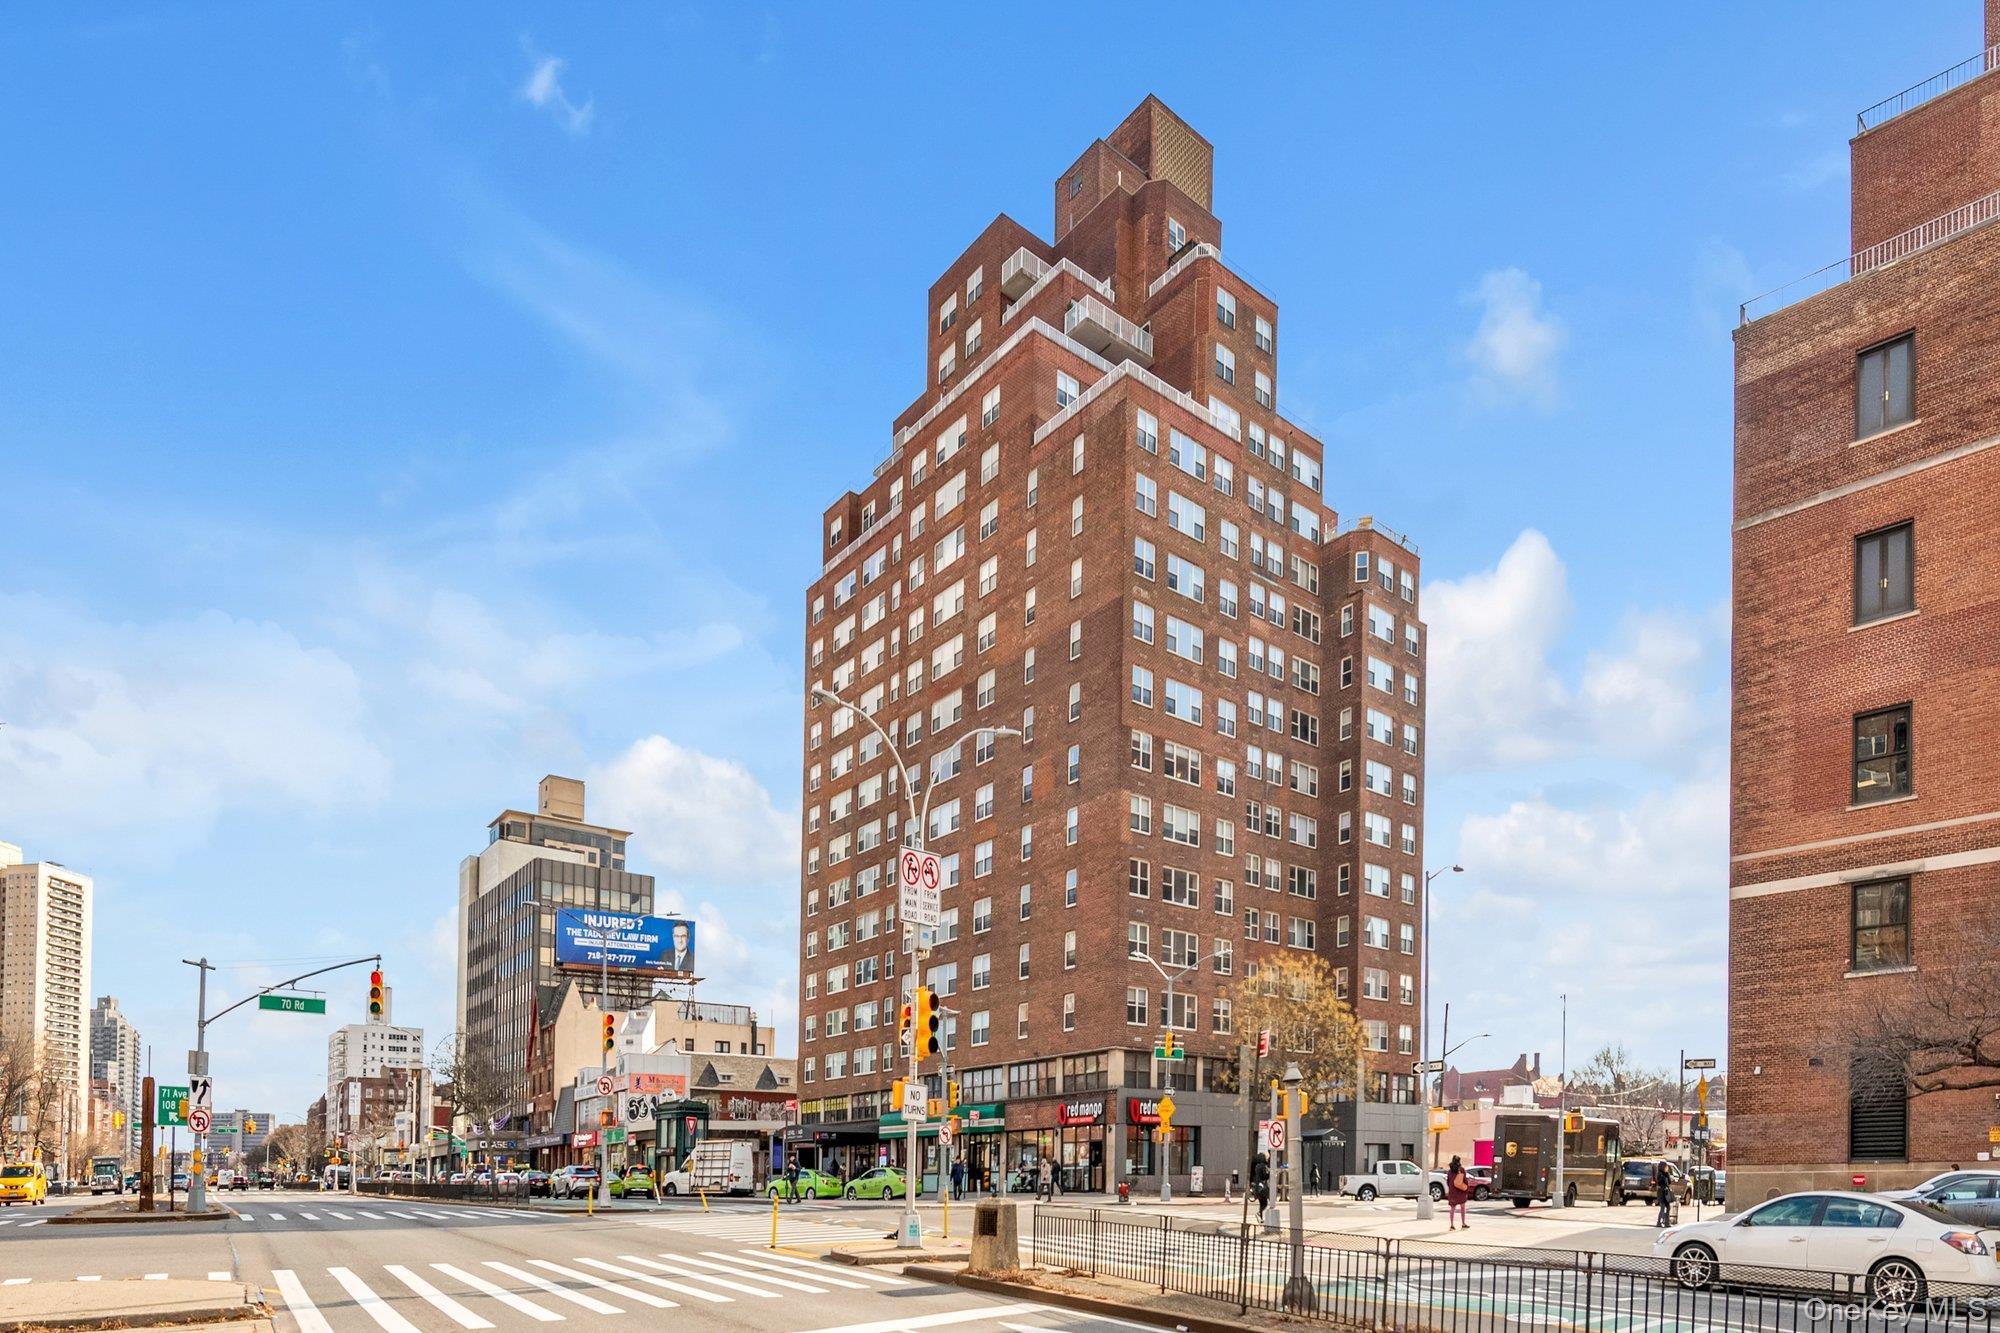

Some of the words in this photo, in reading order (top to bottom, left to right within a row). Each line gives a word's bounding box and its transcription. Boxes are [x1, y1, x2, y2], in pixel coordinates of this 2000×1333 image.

[904, 886, 917, 895] FROM
[924, 890, 937, 899] FROM
[905, 899, 917, 907] MAIN
[904, 910, 917, 919] ROAD
[924, 913, 937, 923] ROAD
[584, 914, 635, 930] INJURED
[566, 927, 582, 936] THE
[622, 932, 639, 942] LAW
[640, 934, 658, 943] FIRM
[587, 951, 636, 963] 718-27-7777
[281, 999, 291, 1009] 70
[294, 1000, 304, 1010] Rd
[162, 1088, 170, 1097] 71
[172, 1089, 188, 1098] Ave
[910, 1090, 921, 1101] NO
[162, 1100, 176, 1110] 108
[904, 1104, 925, 1115] TURNS
[1067, 1101, 1079, 1117] red
[1079, 1101, 1102, 1118] mango
[1140, 1099, 1151, 1115] red
